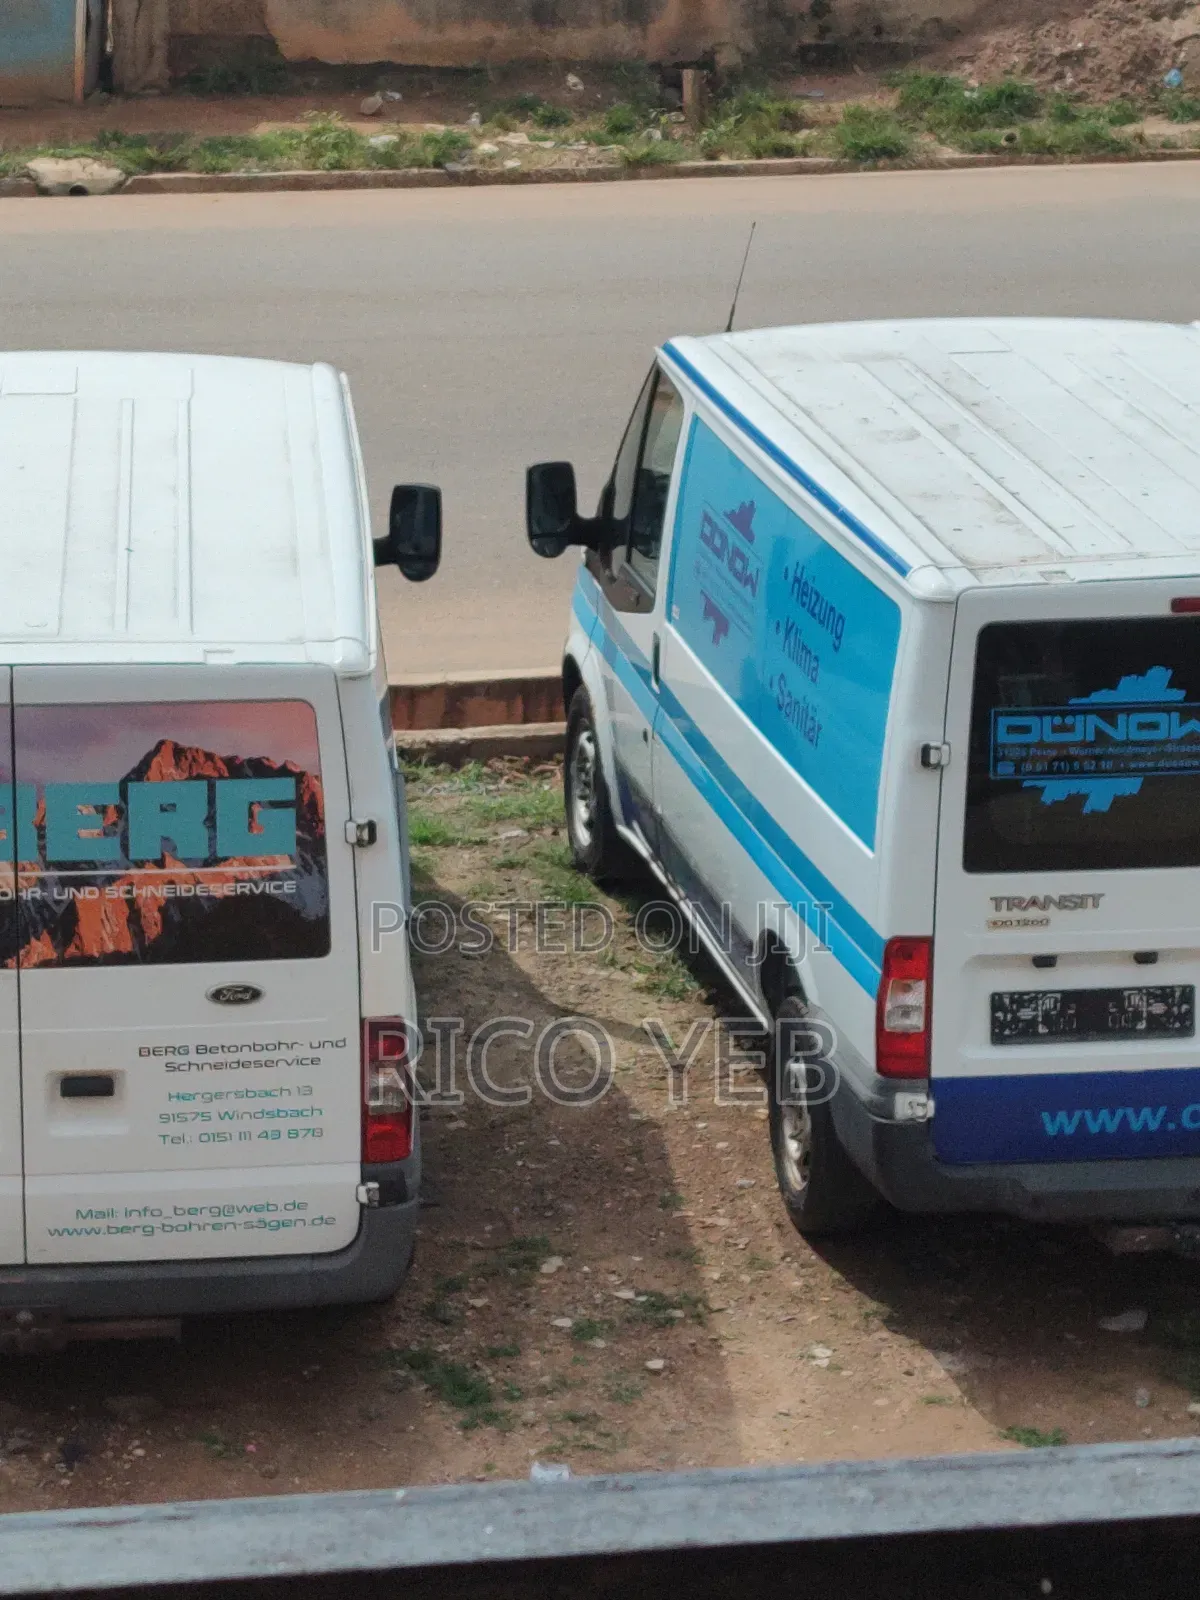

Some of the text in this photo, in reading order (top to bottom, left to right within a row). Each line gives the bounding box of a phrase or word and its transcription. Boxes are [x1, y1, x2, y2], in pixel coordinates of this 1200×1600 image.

[789, 560, 847, 654] Heizung
[780, 616, 820, 685] Klima
[775, 671, 823, 748] Sanitär
[53, 885, 99, 900] UND
[105, 880, 297, 899] SCHNEIDESERVICE
[989, 892, 1105, 913] TRANSIT
[138, 1045, 190, 1058] BERG
[309, 1037, 347, 1050] und
[164, 1055, 322, 1073] Schneideservice
[168, 1085, 314, 1104] Hergersbach 13
[158, 1105, 324, 1125] 91575 Windsbach
[75, 1207, 120, 1221] Mail:
